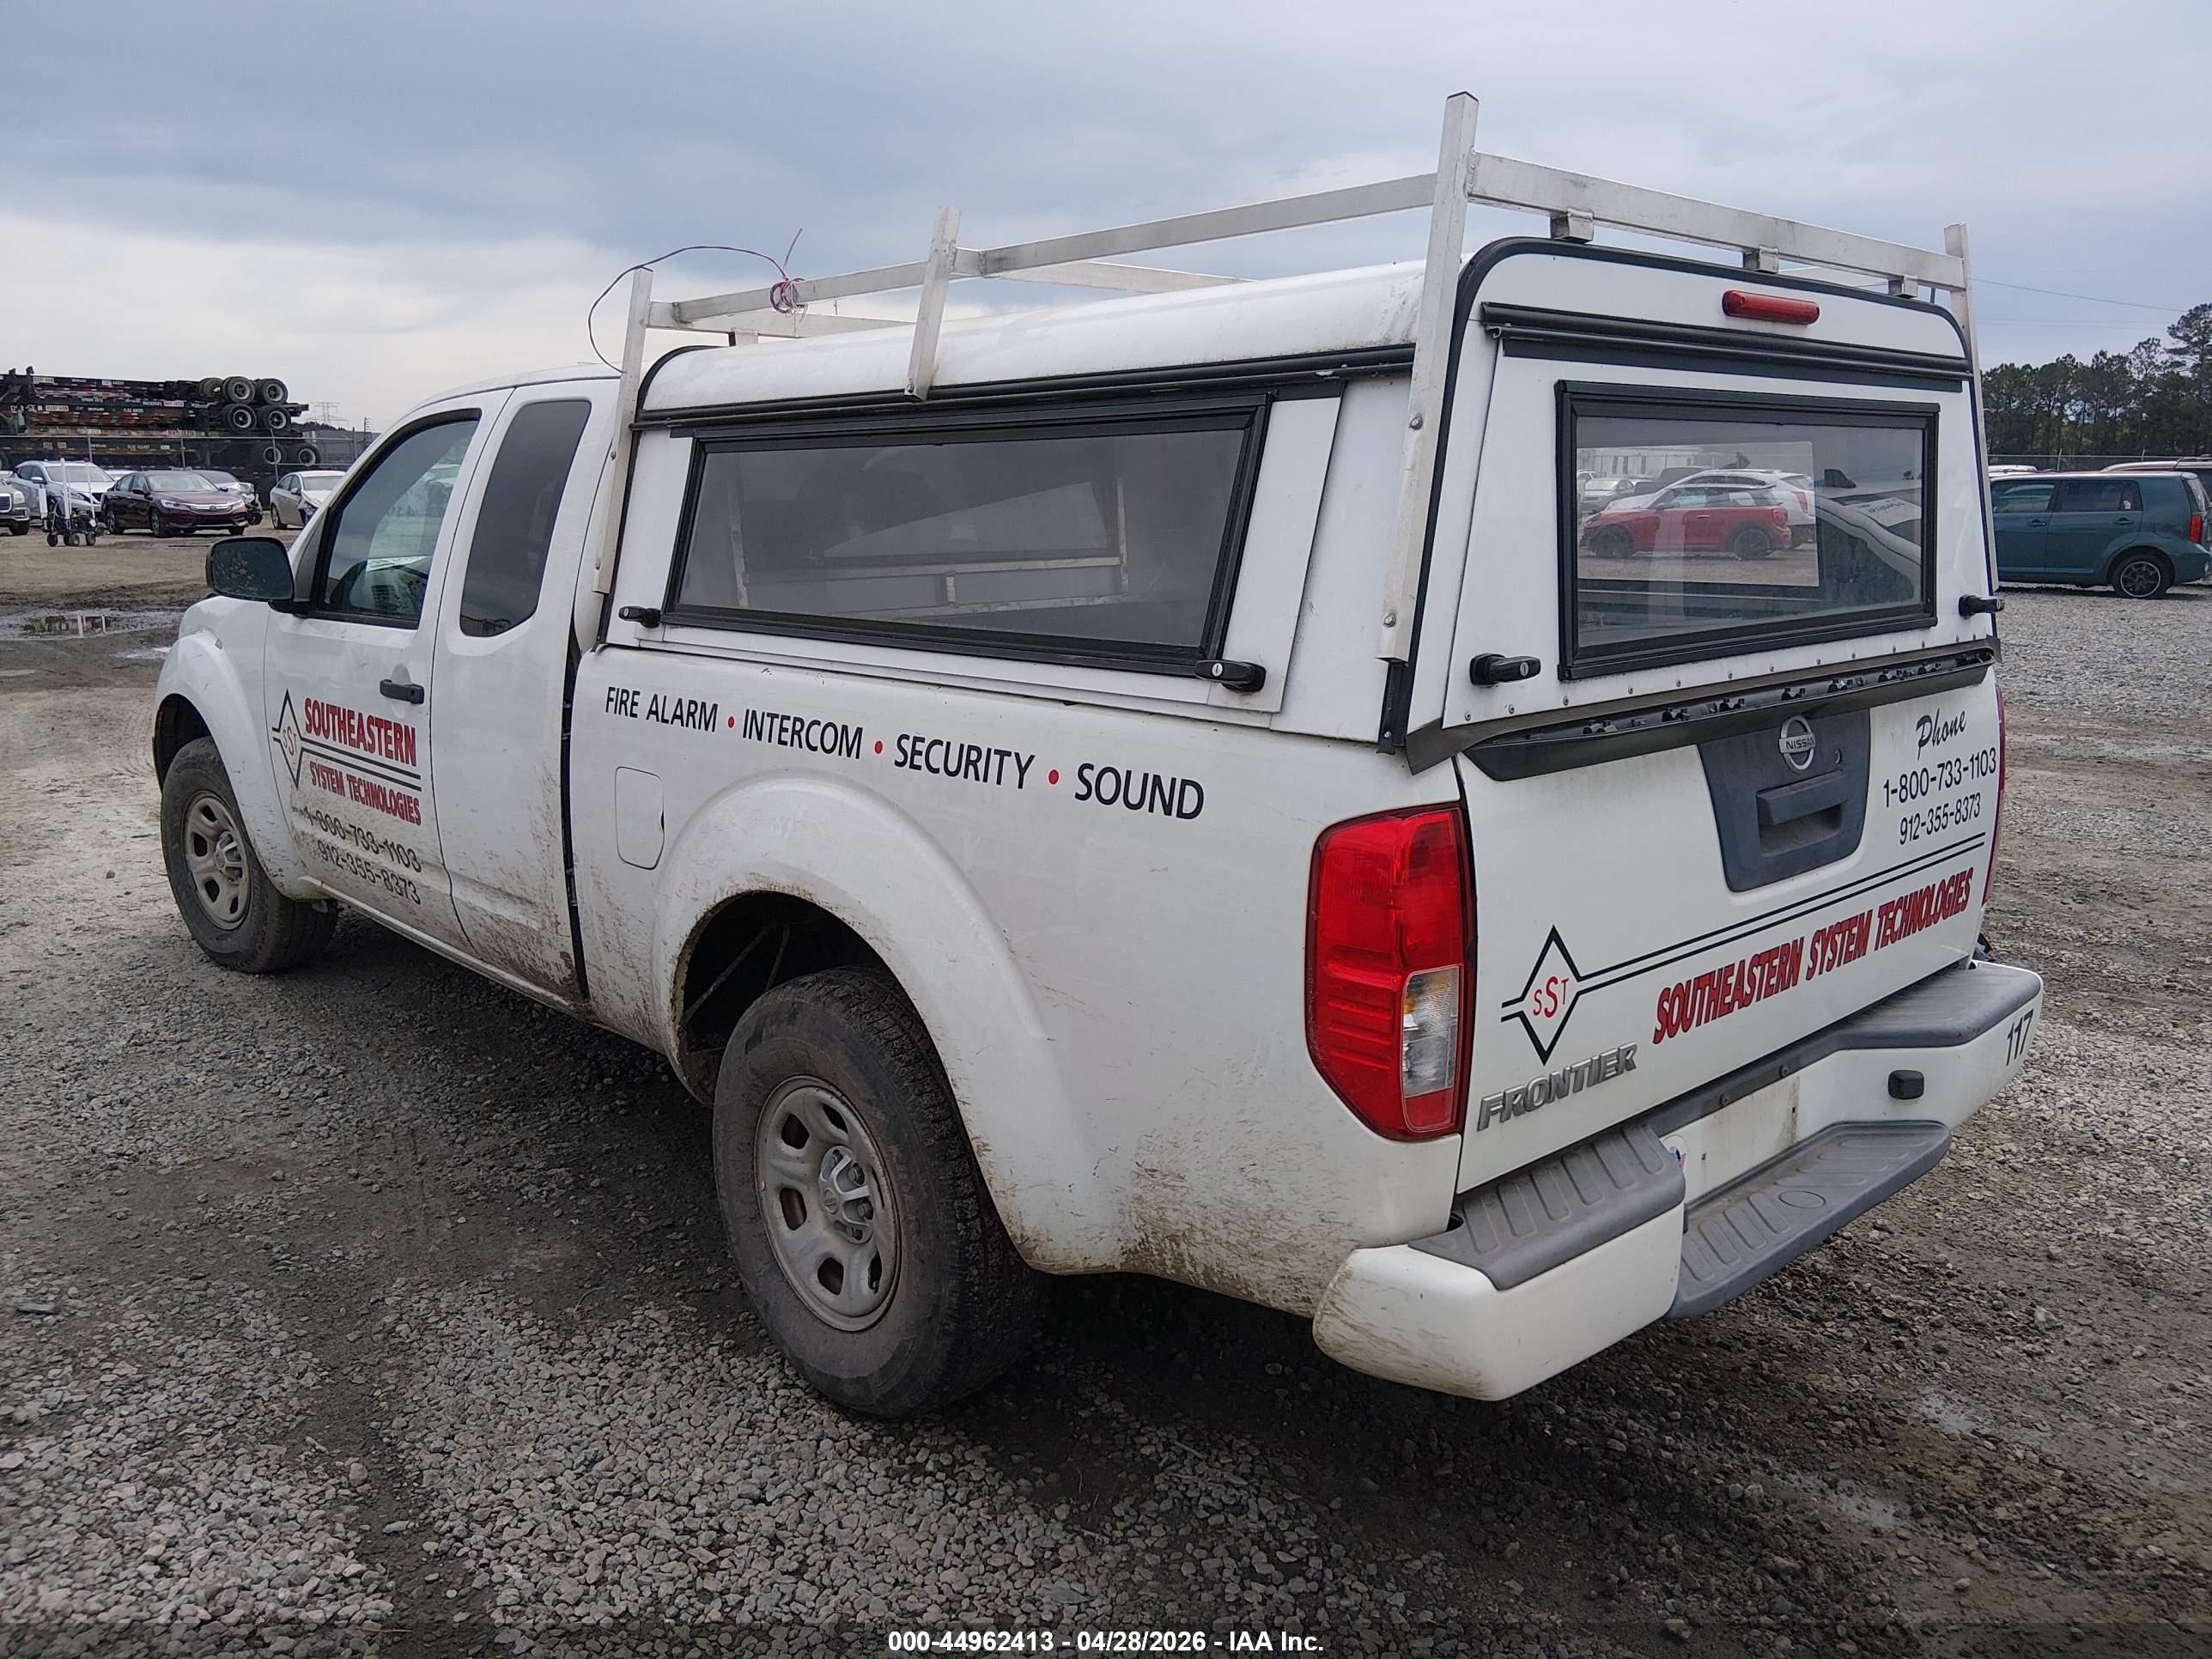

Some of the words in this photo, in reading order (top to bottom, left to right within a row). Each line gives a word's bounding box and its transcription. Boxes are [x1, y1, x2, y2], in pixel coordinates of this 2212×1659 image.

[304, 697, 417, 767] SOUTHEASTERN
[605, 686, 641, 719] FIRE
[646, 693, 718, 732] ALARM
[742, 708, 864, 760] INTERCOM
[894, 733, 1036, 790] SECURITY
[1074, 762, 1205, 820] SOUND
[1785, 736, 1814, 750] NISSAN
[1916, 708, 1966, 761] Phone
[309, 760, 345, 797] SYSTEM
[346, 774, 422, 826] TECHNOLOGIES
[1883, 746, 1996, 808] 1-800-733-1103
[303, 805, 422, 873] 1-800-733-1103
[1899, 792, 1981, 846] 912-355-8373
[317, 839, 422, 905] 912-355-8373
[1652, 936, 1804, 1045] SOUTHEASTERN
[1805, 908, 1873, 981] SYSTEM
[1874, 867, 1974, 951] TECHNOLOGIES
[1532, 975, 1570, 1018] SST
[2005, 1008, 2034, 1067] 117
[1477, 1042, 1638, 1133] FRONTIER
